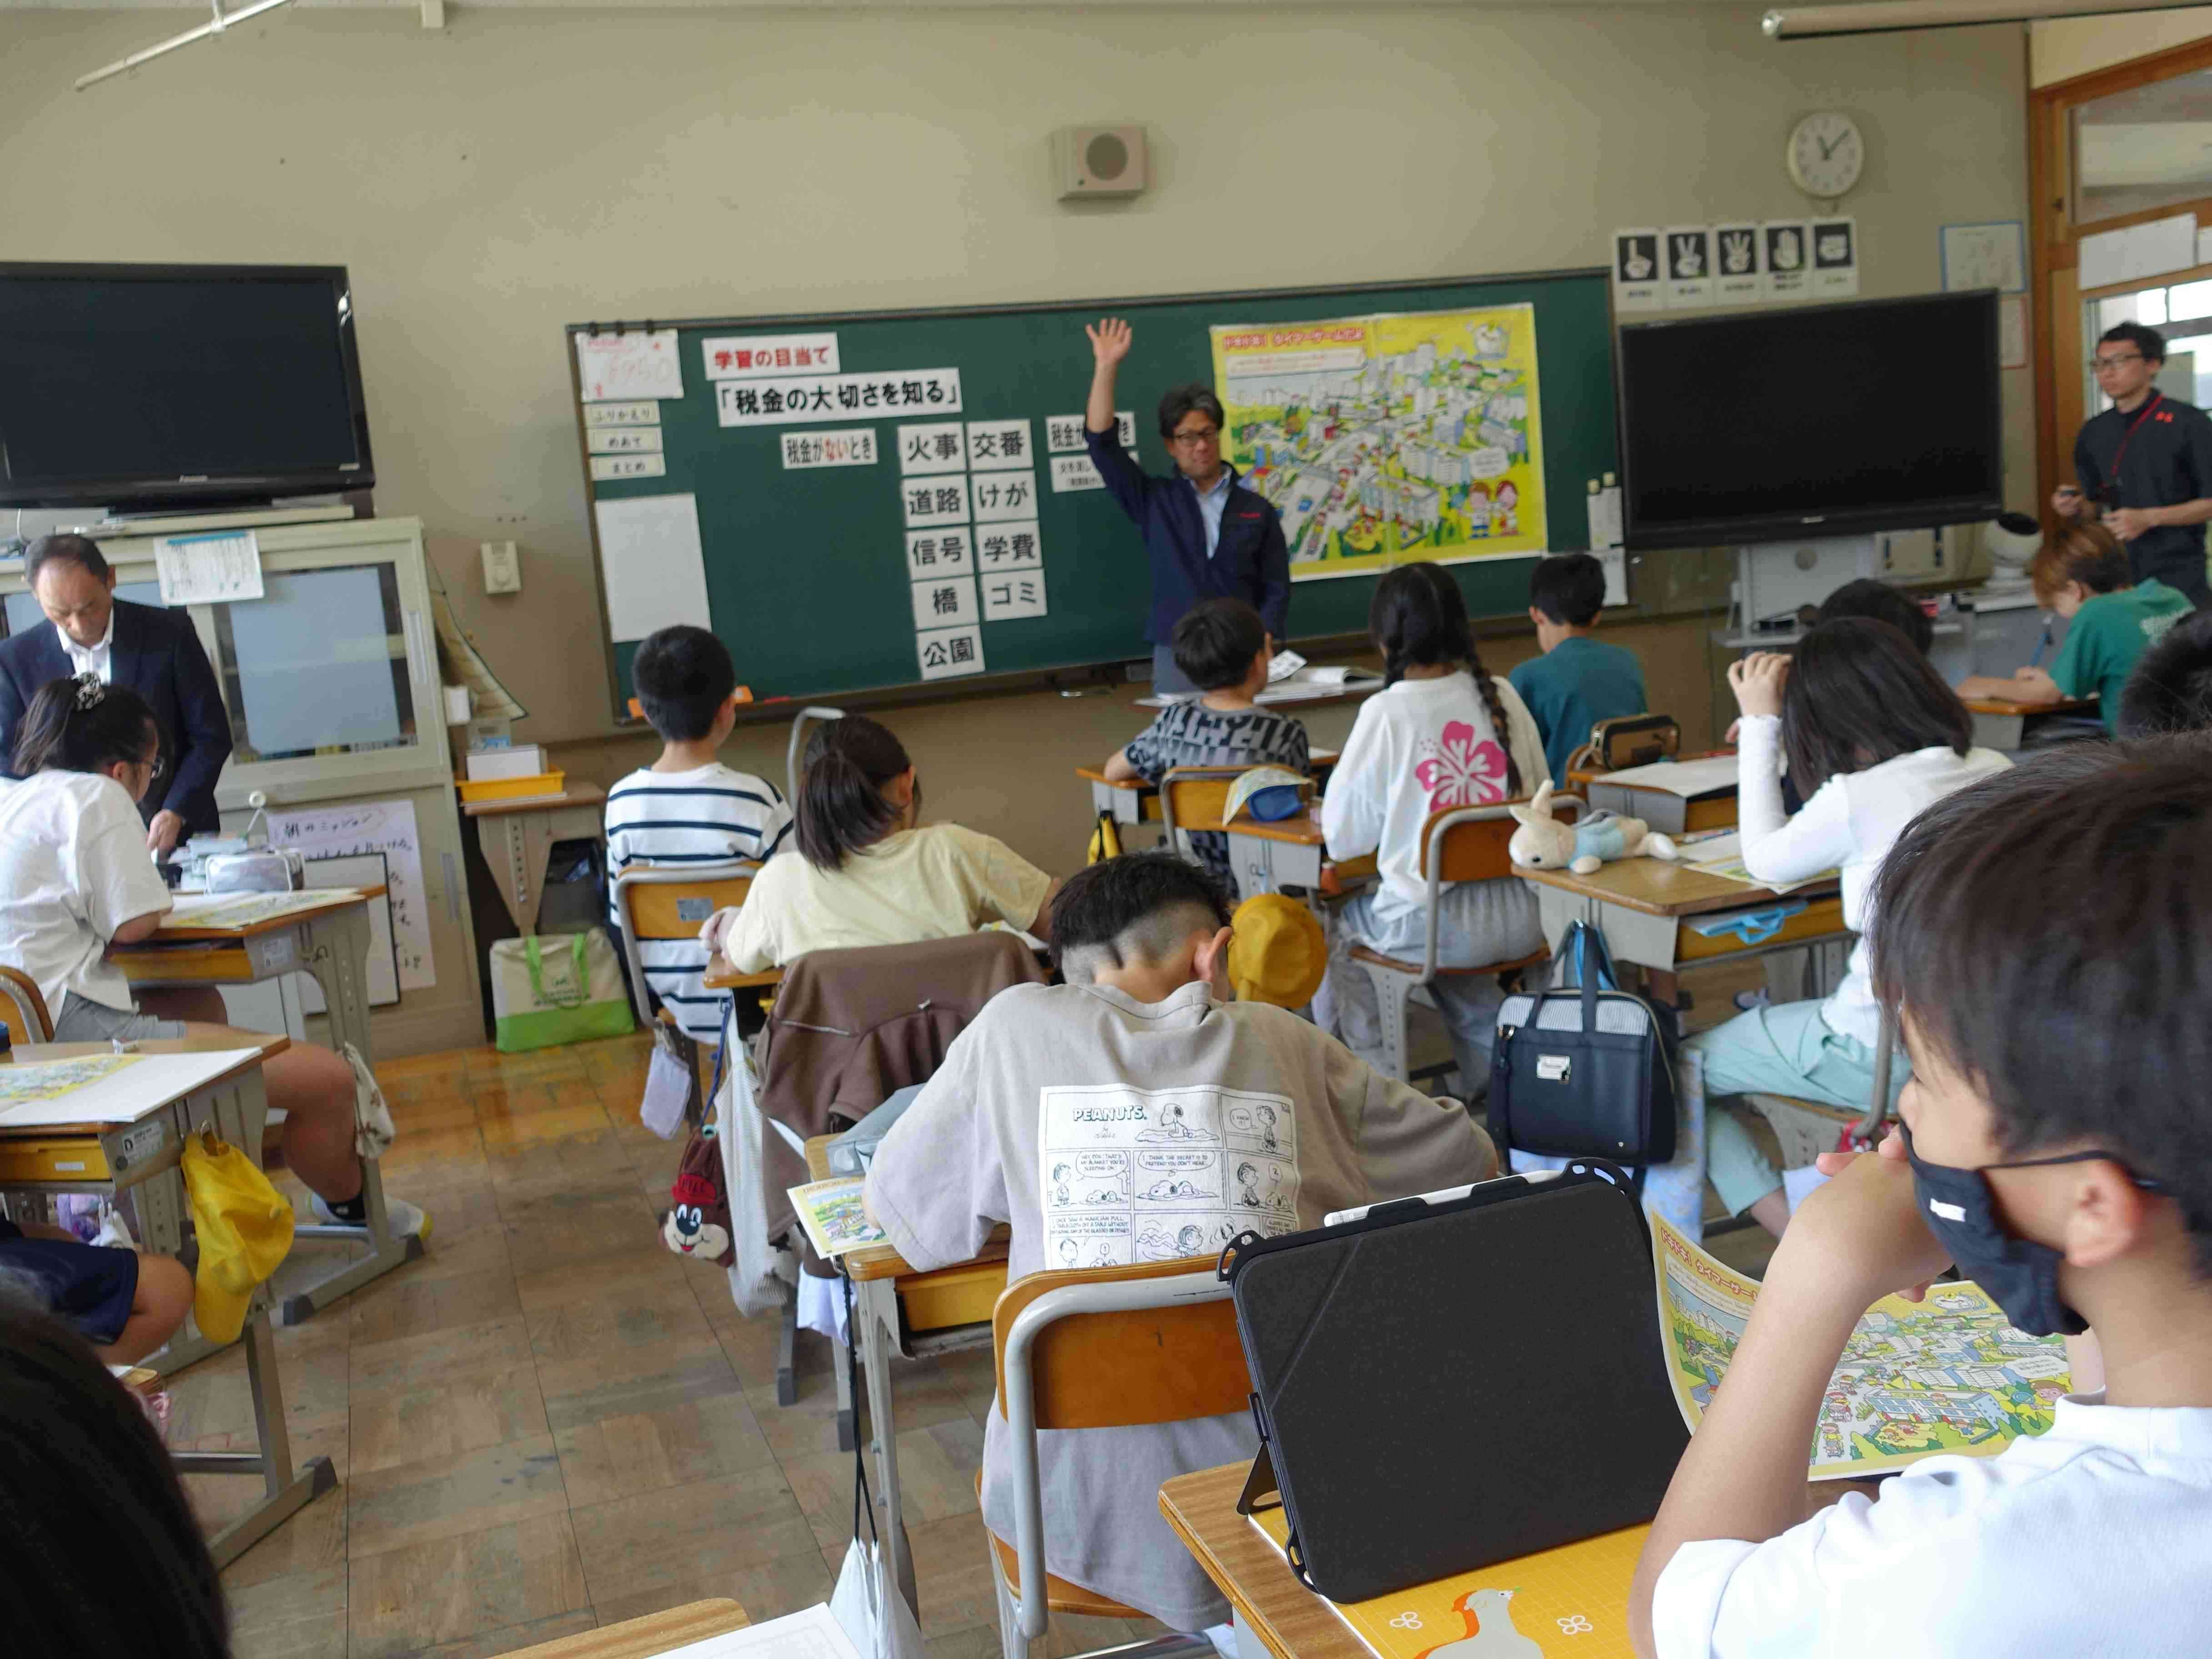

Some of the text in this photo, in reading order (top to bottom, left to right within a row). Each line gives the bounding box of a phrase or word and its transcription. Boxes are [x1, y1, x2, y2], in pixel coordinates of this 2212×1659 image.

[714, 346, 830, 370] 学習の目当て
[721, 380, 956, 416] 「税金の大切さを知る」
[609, 436, 641, 448] めあて
[787, 436, 872, 465] 税金がないとき
[907, 433, 959, 462] 火事
[972, 430, 1025, 459] 交番
[909, 488, 960, 516] 道路
[978, 480, 1028, 508] けが
[913, 537, 965, 567] 信号
[984, 533, 1035, 562] 学費
[933, 587, 959, 615] 橋
[991, 582, 1037, 605] ゴミ
[924, 637, 975, 668] 公園
